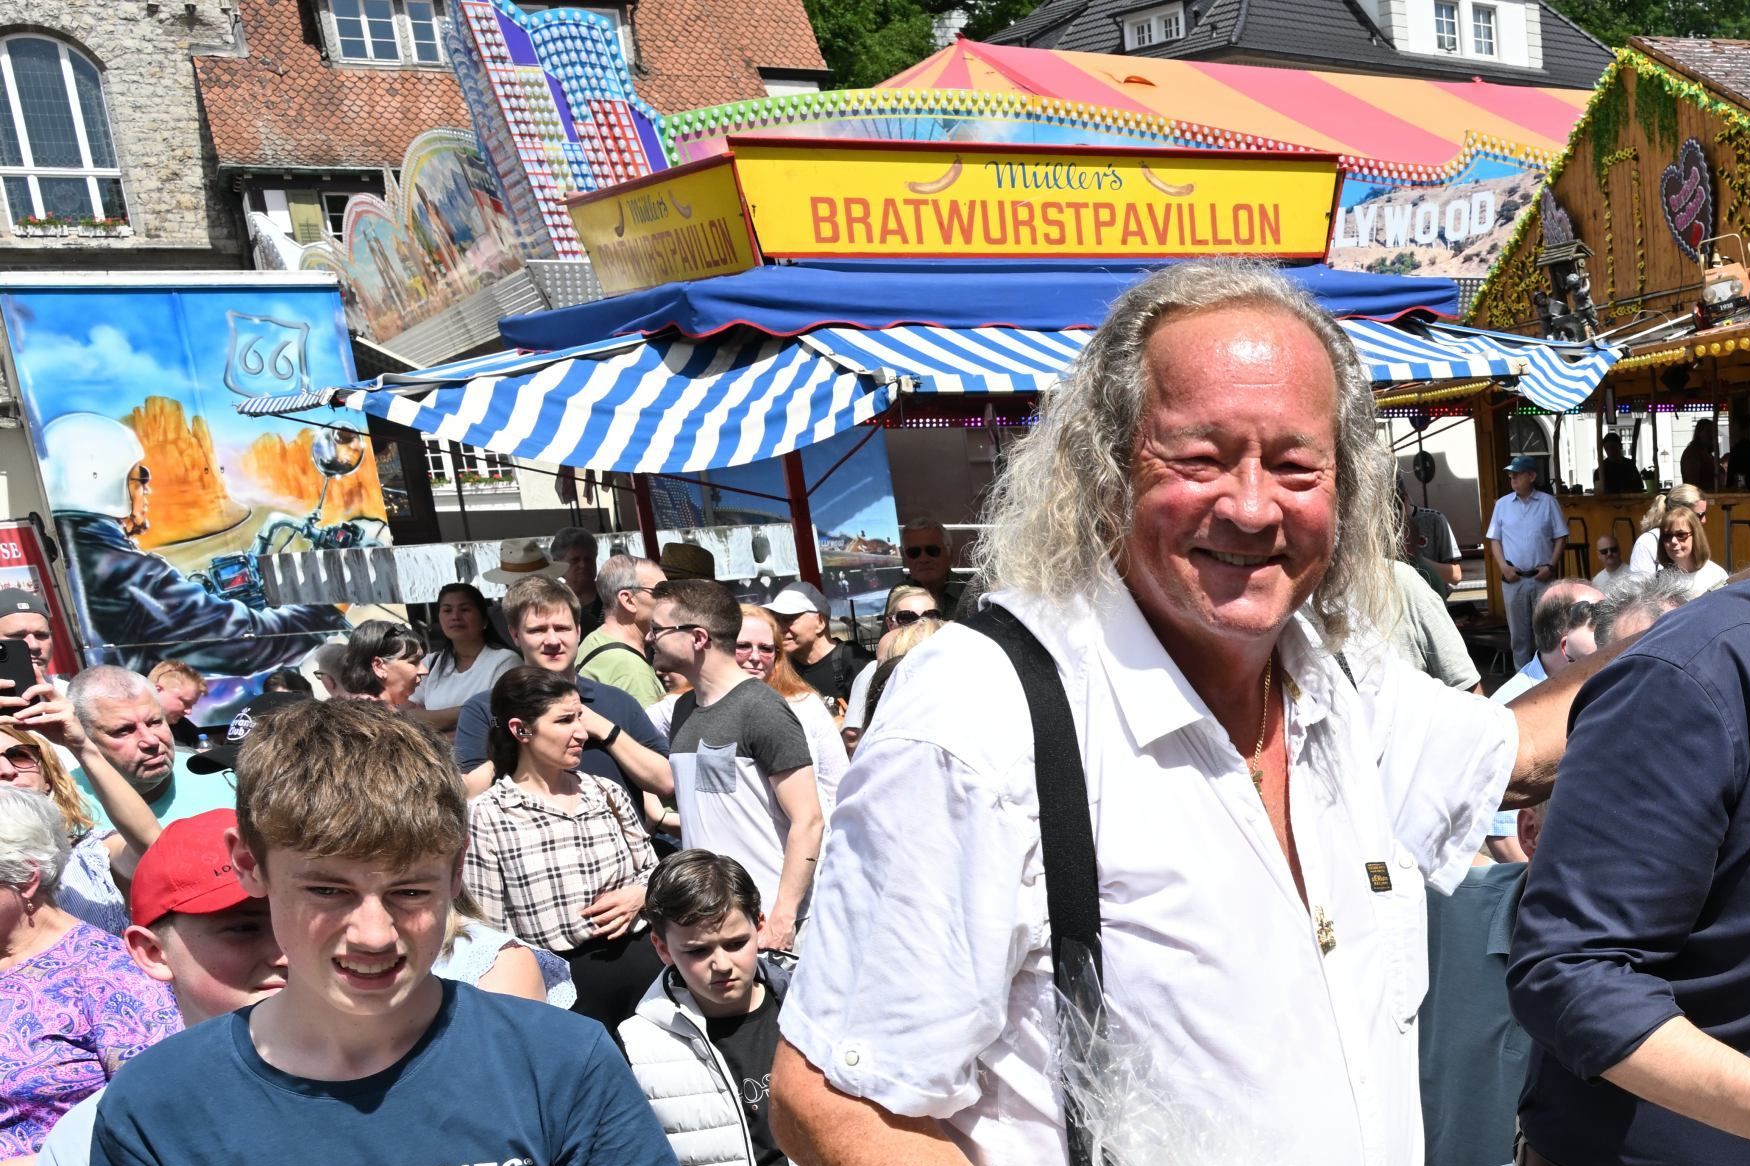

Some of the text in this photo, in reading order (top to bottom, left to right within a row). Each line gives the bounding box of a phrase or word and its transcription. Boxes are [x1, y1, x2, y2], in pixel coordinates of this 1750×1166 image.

[985, 161, 1123, 191] Müller's
[809, 196, 1282, 246] BRATWURSTPAVILLON
[1331, 190, 1496, 248] LYWOOD
[597, 217, 739, 282] BRATWURSTPAVILLON
[238, 336, 295, 381] 66
